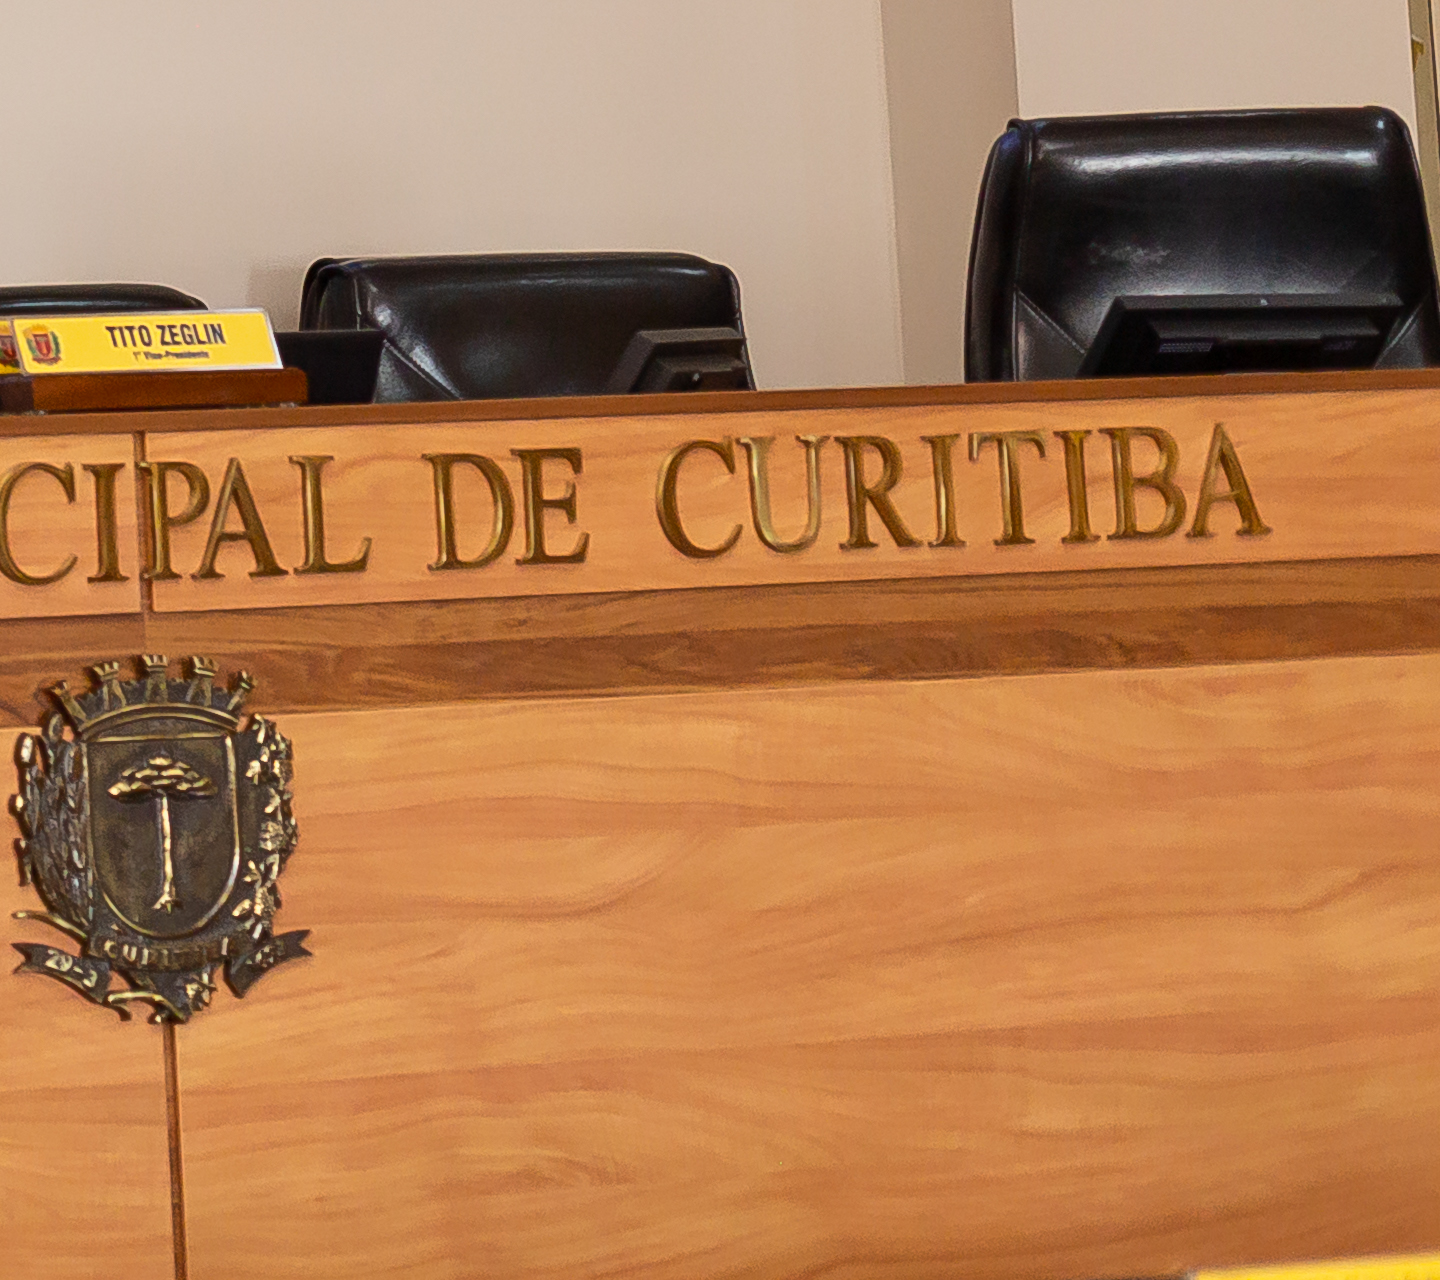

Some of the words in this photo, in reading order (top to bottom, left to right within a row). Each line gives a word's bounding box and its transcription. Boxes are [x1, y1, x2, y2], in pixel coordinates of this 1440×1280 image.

[105, 325, 152, 347] TITO
[156, 323, 227, 346] ZEGLIN
[421, 446, 591, 571] DE
[656, 423, 1272, 560] CURITIBA
